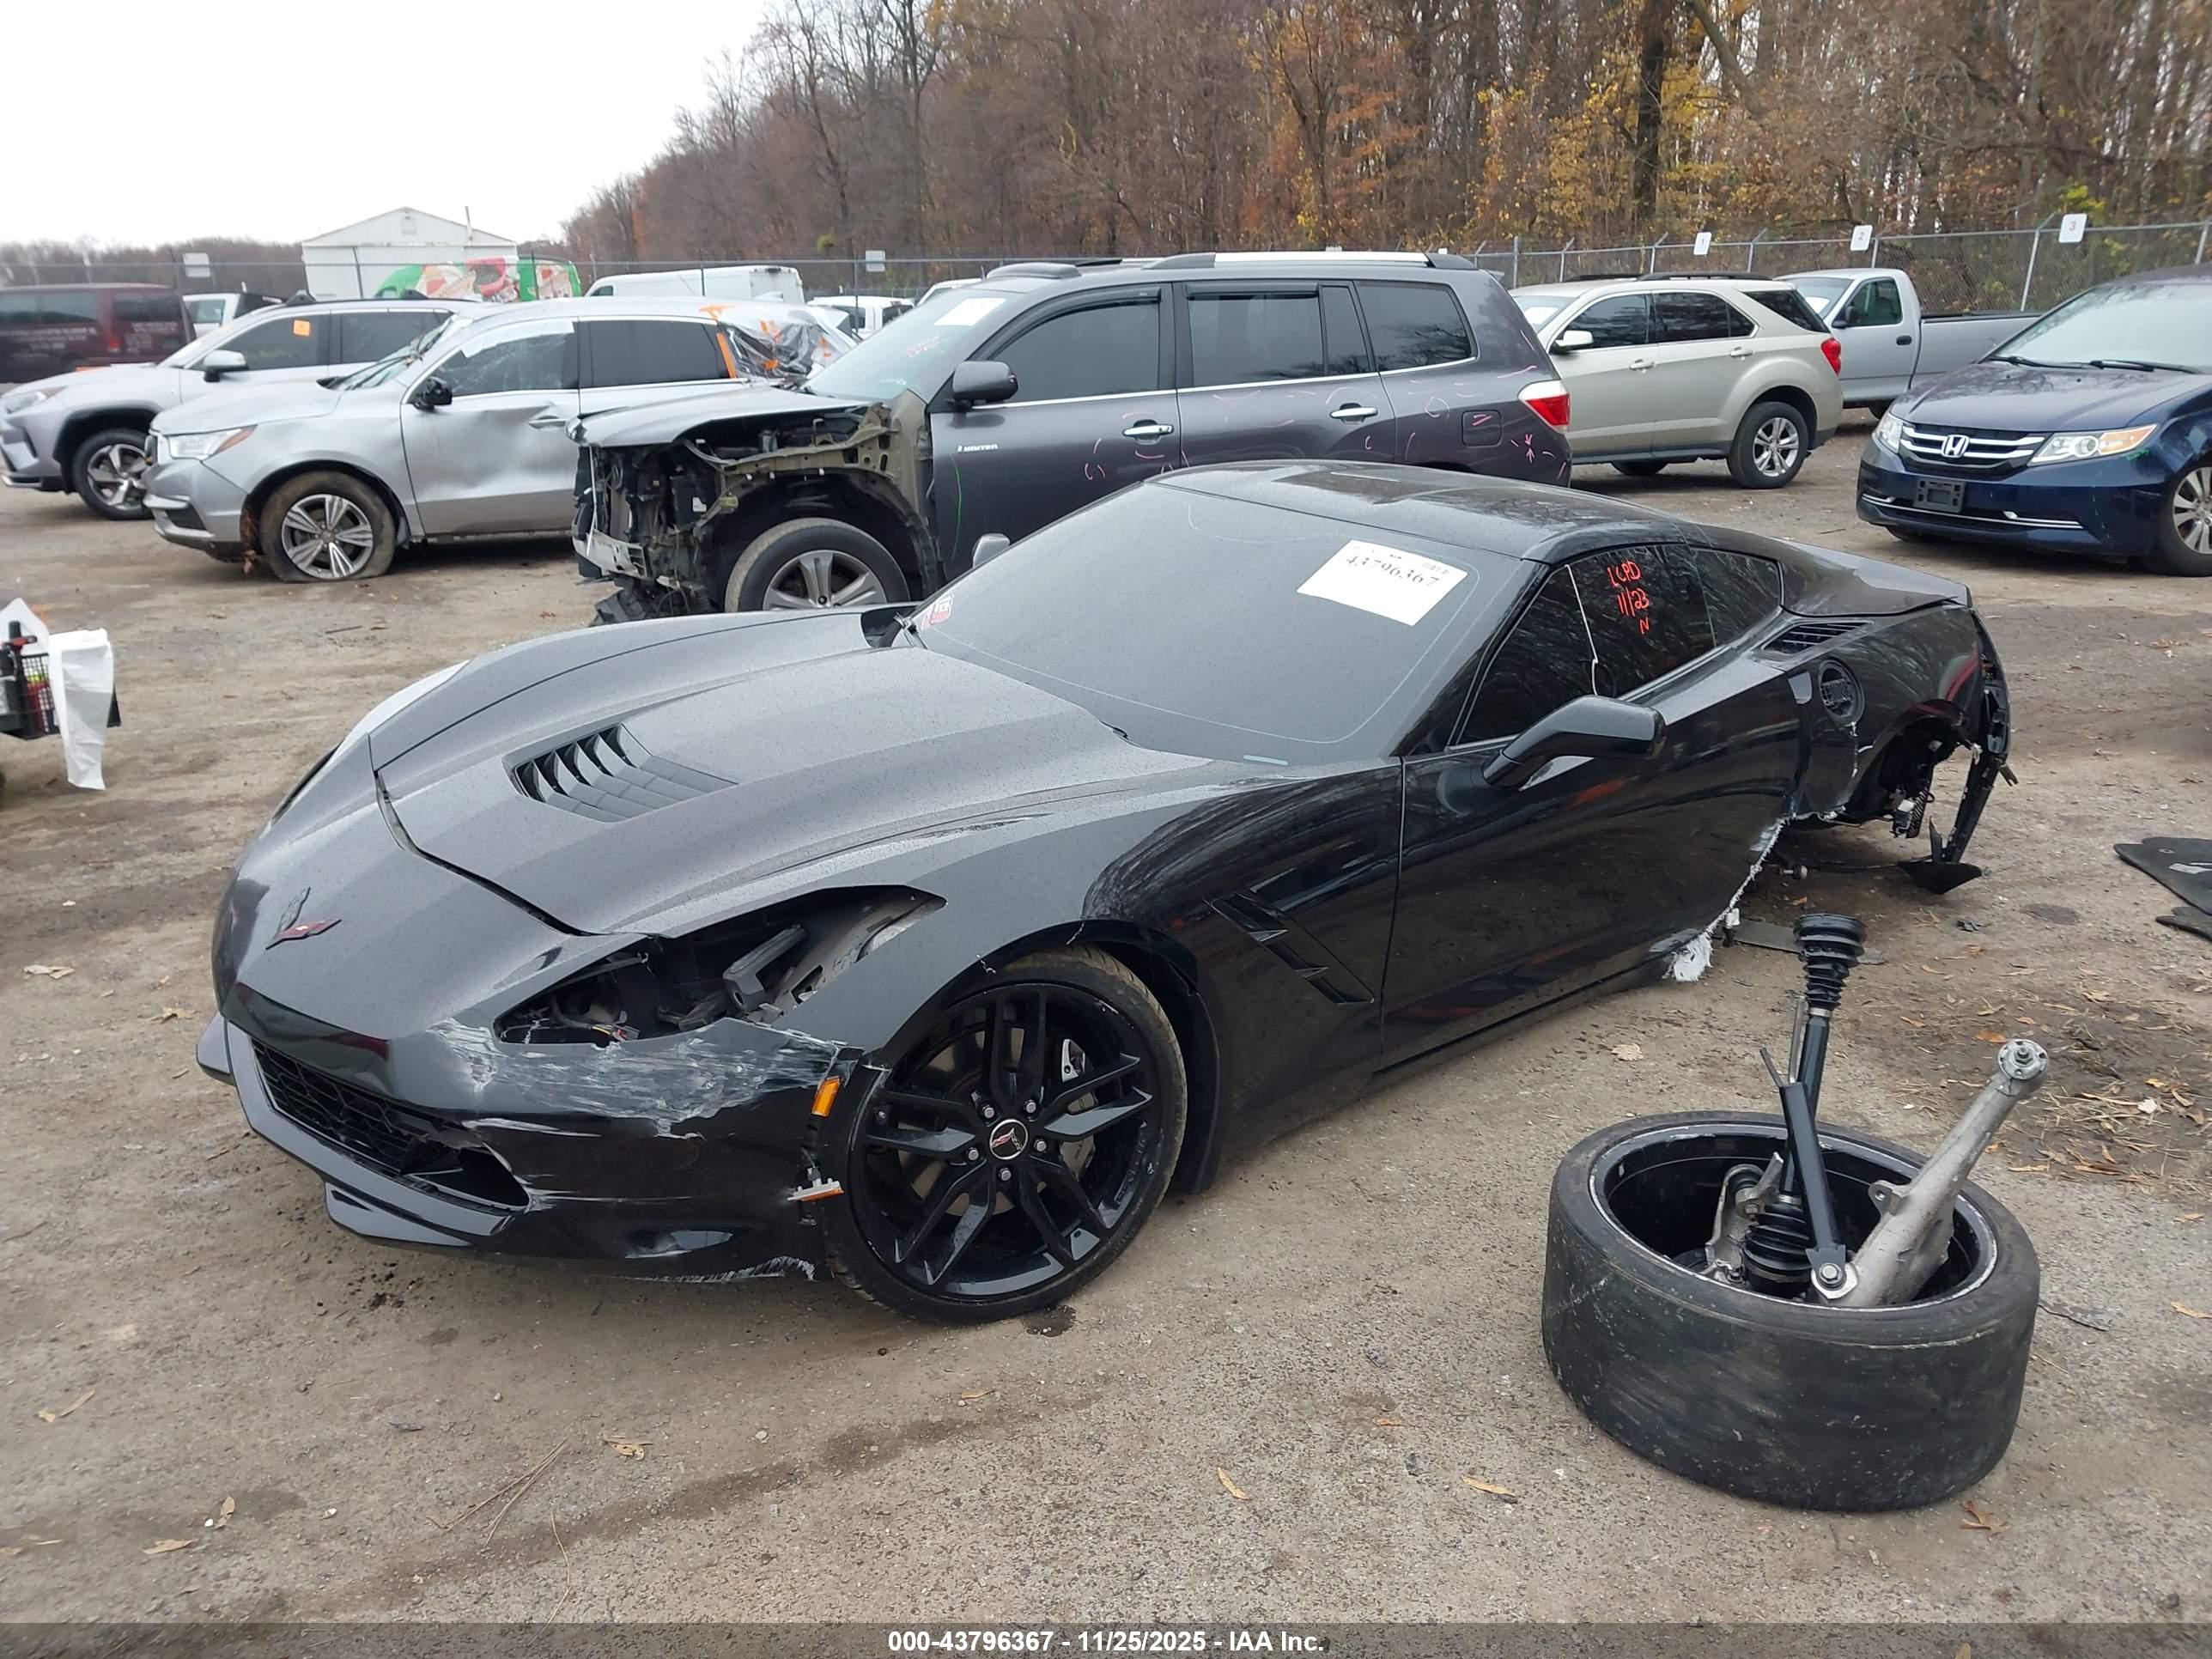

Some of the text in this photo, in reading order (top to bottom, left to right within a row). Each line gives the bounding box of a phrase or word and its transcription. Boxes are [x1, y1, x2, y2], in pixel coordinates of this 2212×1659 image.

[1346, 556, 1440, 586] 43796367
[1616, 586, 1650, 617] 11/23
[1639, 616, 1650, 635] N
